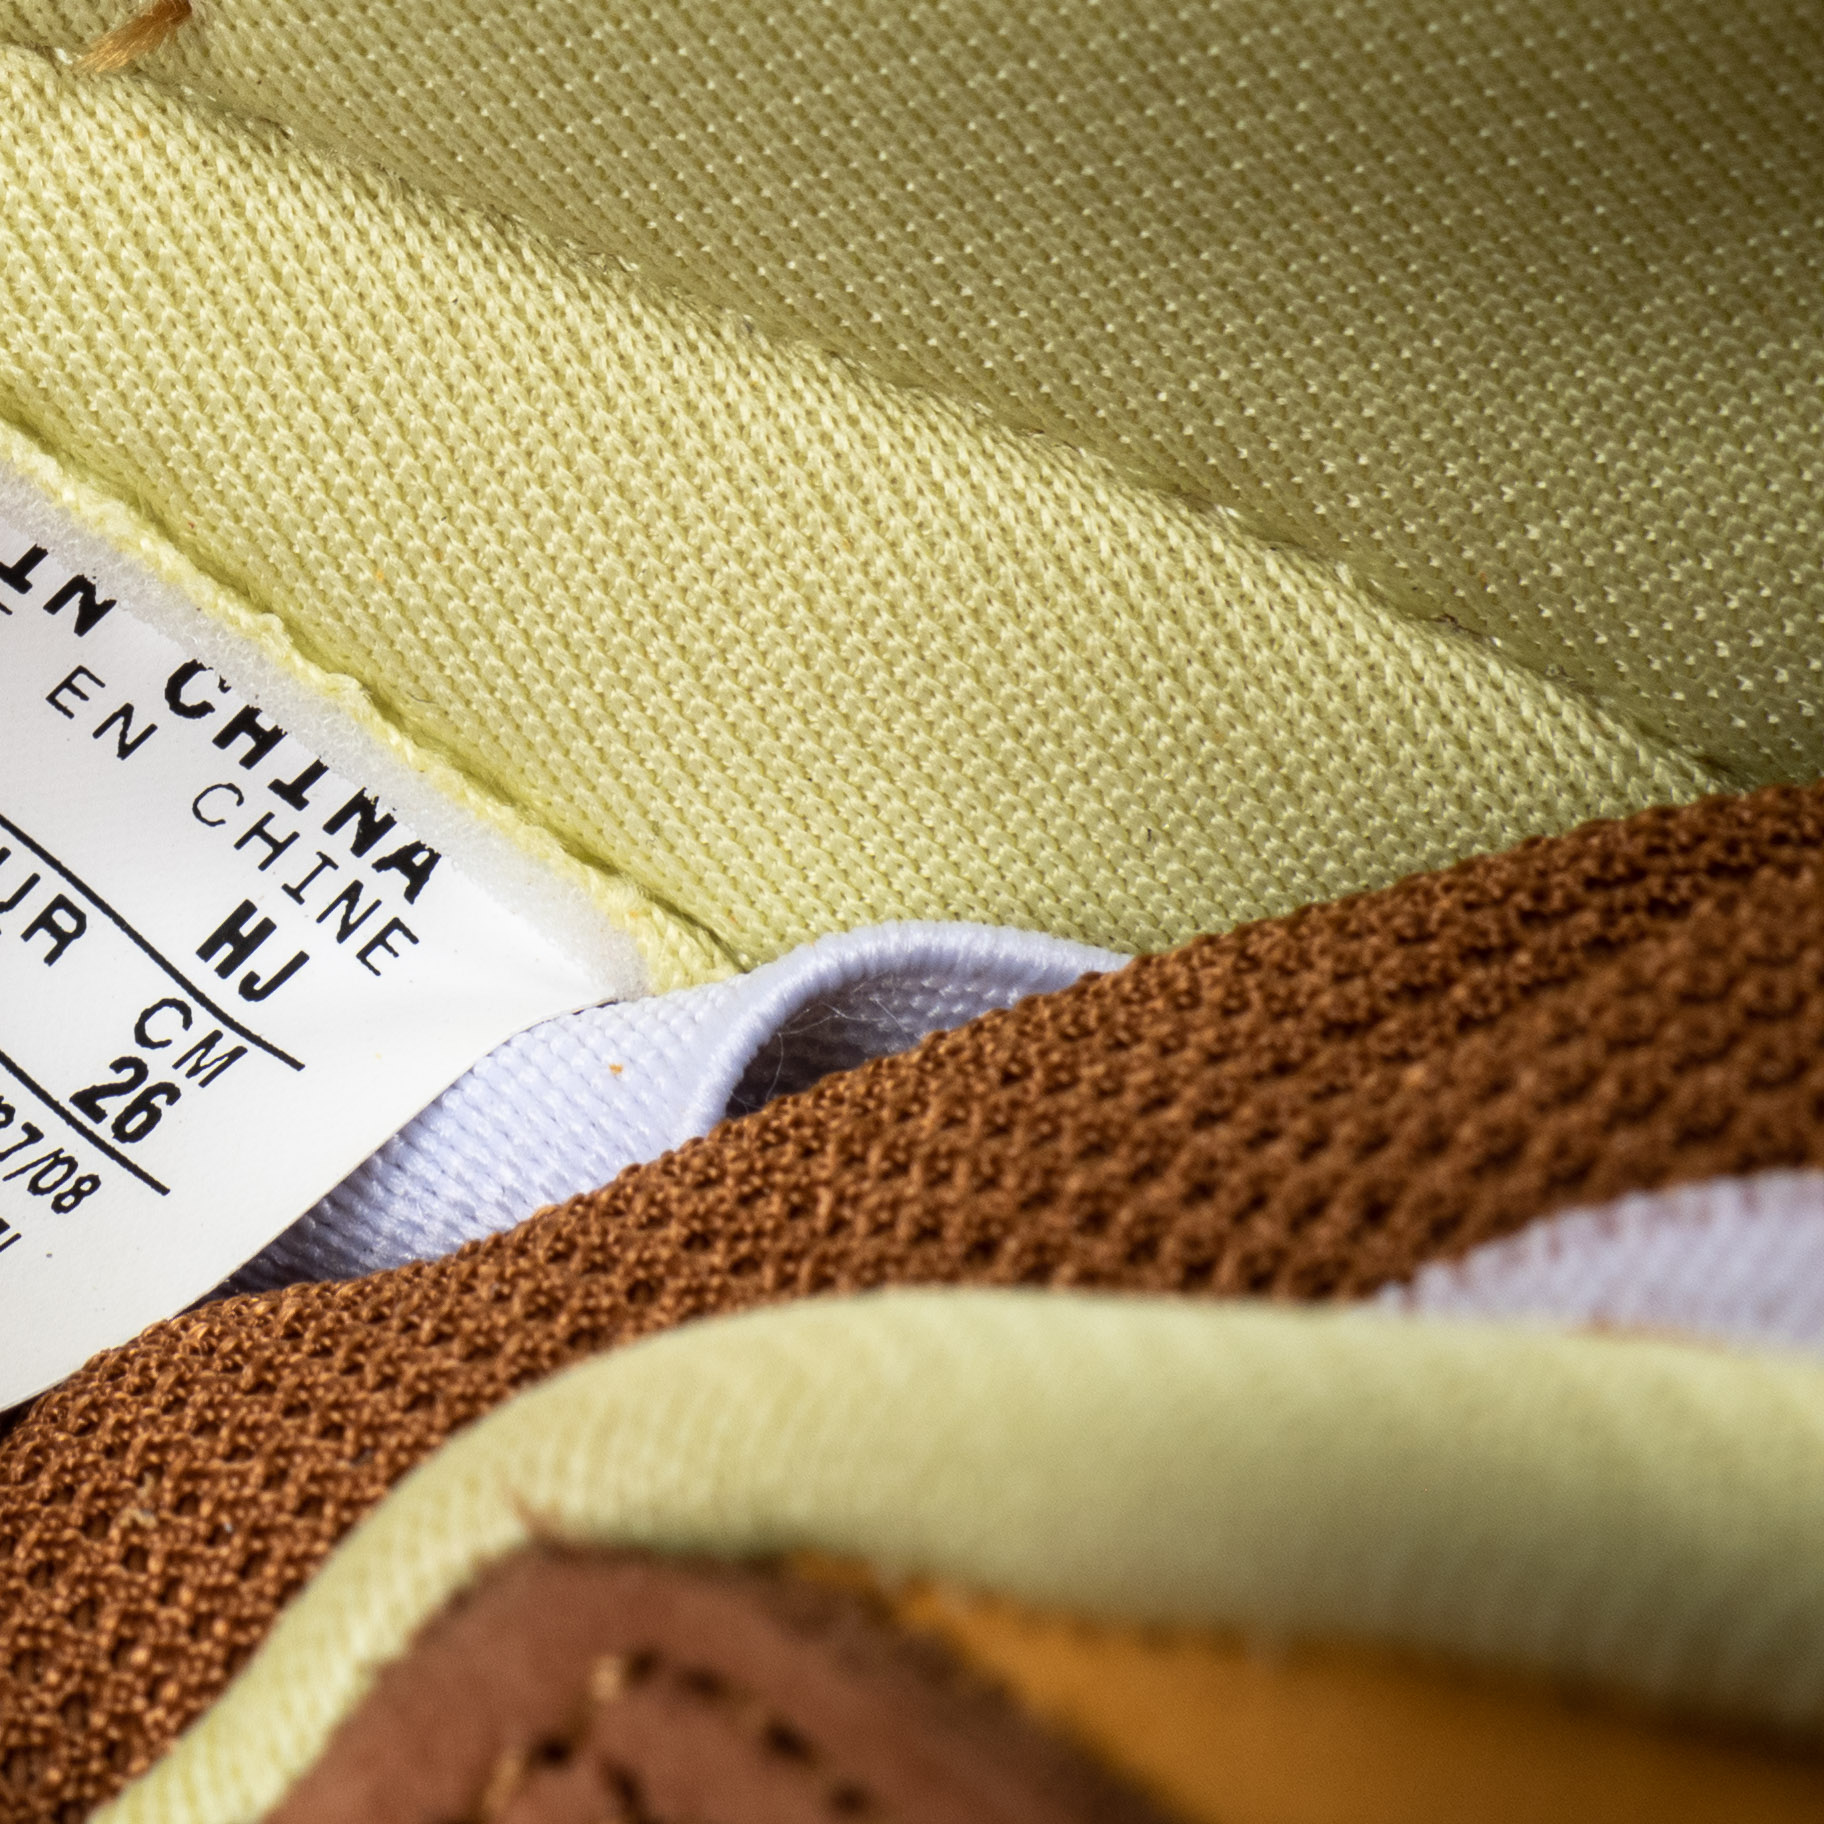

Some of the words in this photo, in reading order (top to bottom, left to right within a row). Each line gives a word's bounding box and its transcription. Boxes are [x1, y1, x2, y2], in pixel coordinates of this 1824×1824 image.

[46, 665, 158, 760] EN
[191, 783, 420, 976] CHINE
[164, 659, 442, 905] CHINA
[196, 898, 310, 1002] HJ
[134, 998, 249, 1088] CM
[69, 1056, 181, 1143] 26
